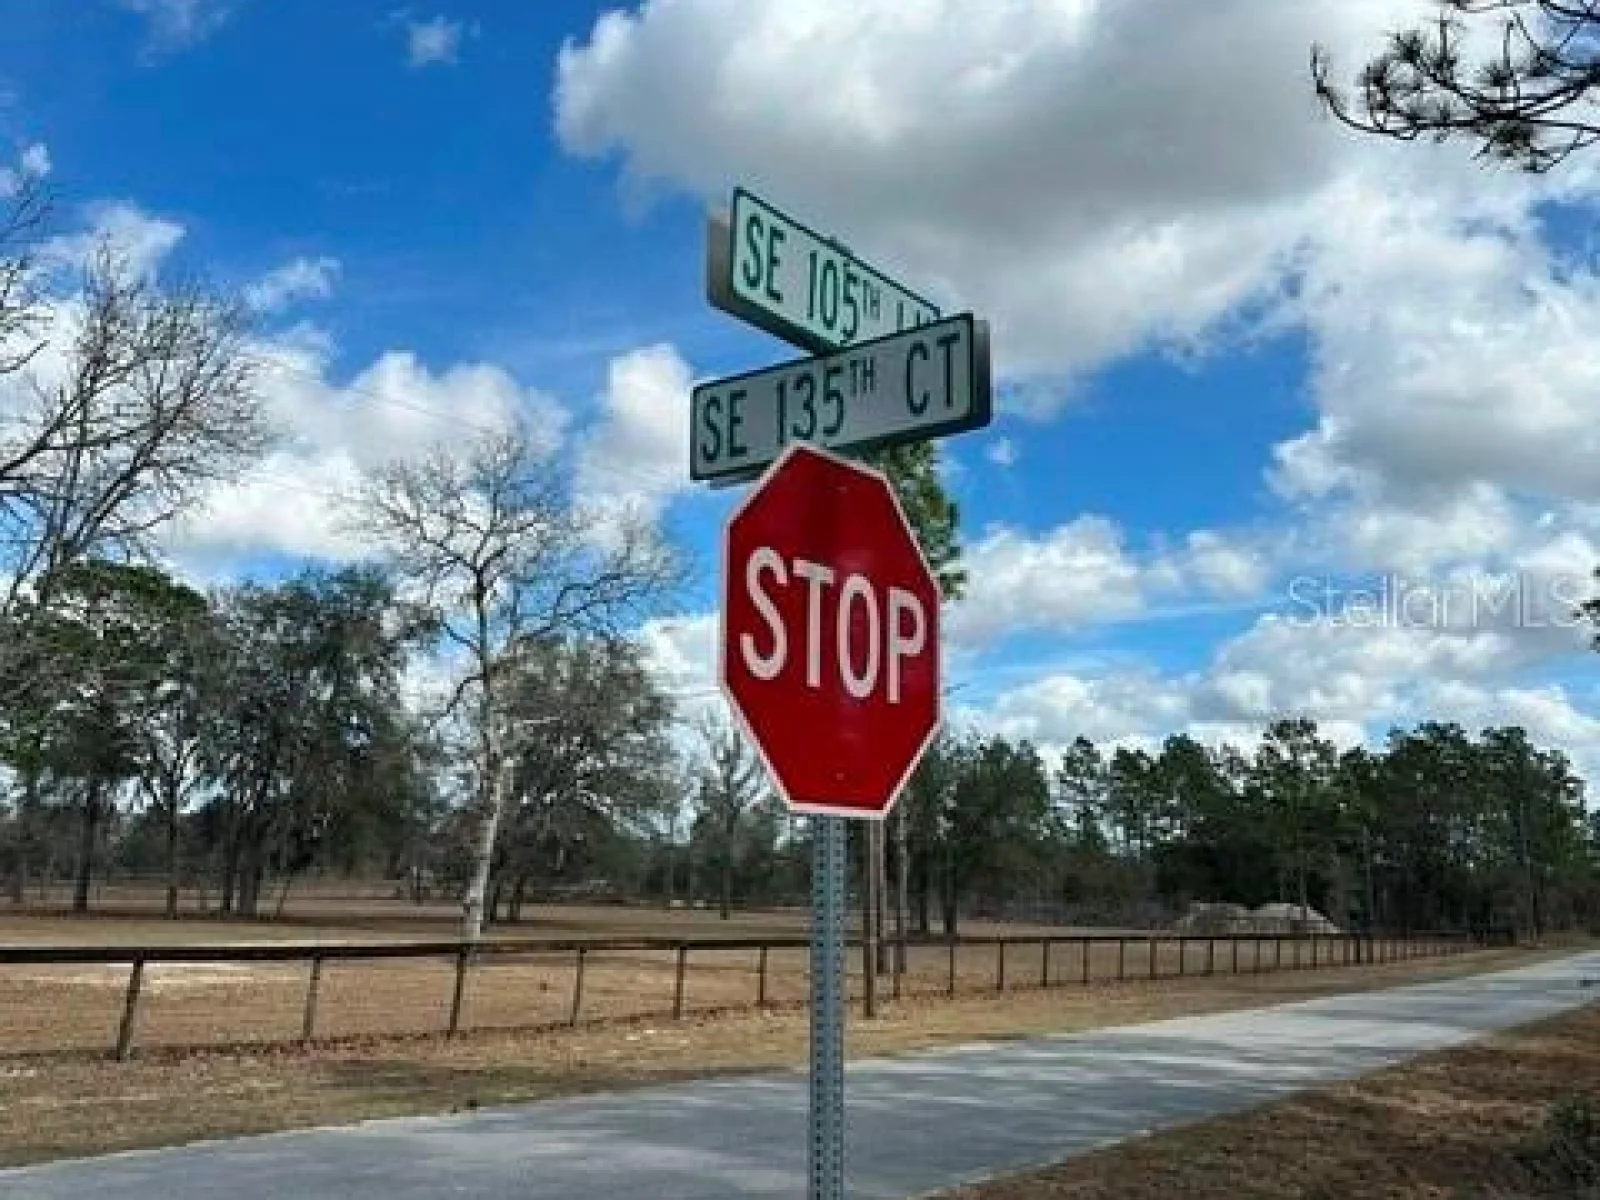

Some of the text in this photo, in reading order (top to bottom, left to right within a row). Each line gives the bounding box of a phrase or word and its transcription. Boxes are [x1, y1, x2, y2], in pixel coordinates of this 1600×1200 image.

[743, 214, 785, 302] SE
[702, 389, 748, 461] SE
[906, 333, 960, 415] CT
[740, 546, 926, 704] STOP
